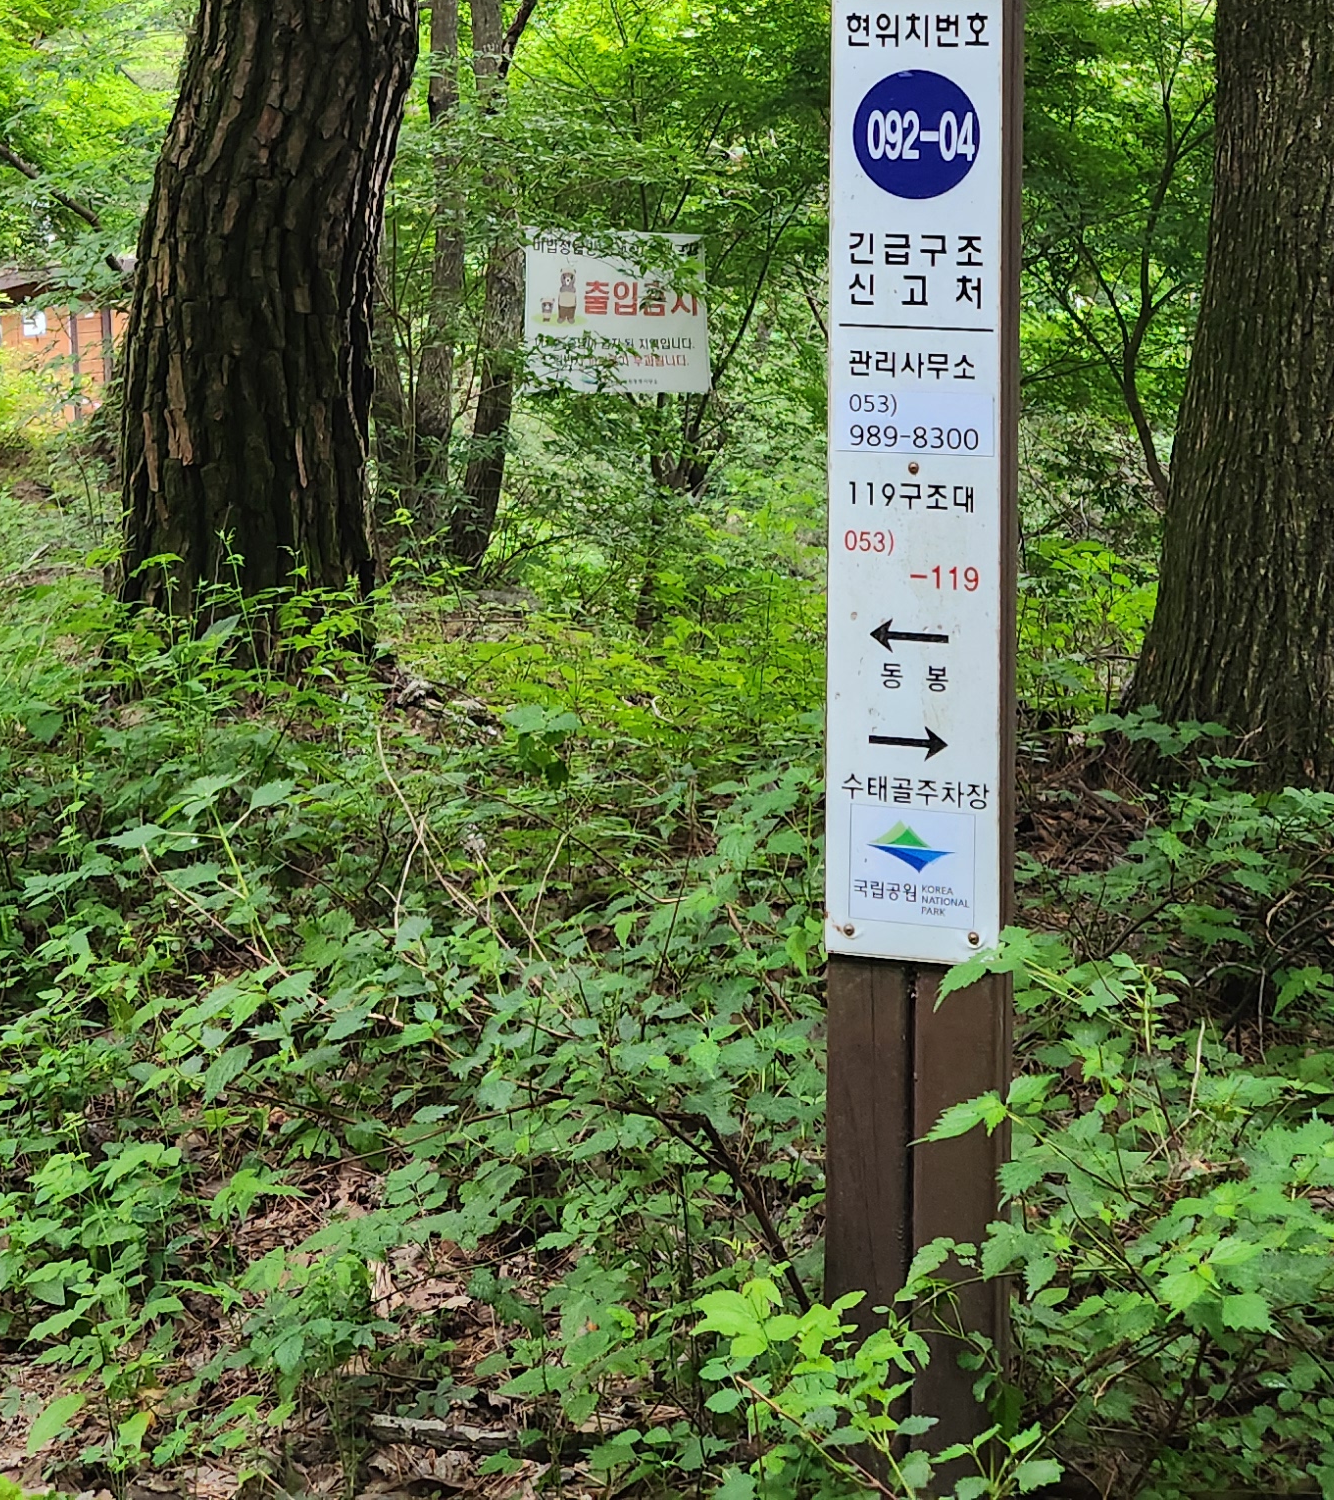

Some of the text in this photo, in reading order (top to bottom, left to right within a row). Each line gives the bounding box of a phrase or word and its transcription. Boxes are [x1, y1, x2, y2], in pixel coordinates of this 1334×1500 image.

[846, 12, 989, 48] 현위치번호
[867, 108, 976, 162] 092-04
[848, 231, 984, 268] 긴급구조
[848, 350, 976, 380] 관리사무소
[849, 393, 898, 417] 053)
[849, 424, 979, 451] 989-8300
[849, 481, 974, 513] 119구조대
[844, 529, 895, 556] 053)
[910, 565, 979, 592] -119
[841, 773, 990, 810] 수태골주차장
[853, 879, 917, 903] 국립공원
[921, 884, 954, 896] KOREA
[921, 895, 970, 909] NATIONAL
[921, 906, 946, 917] PARK
